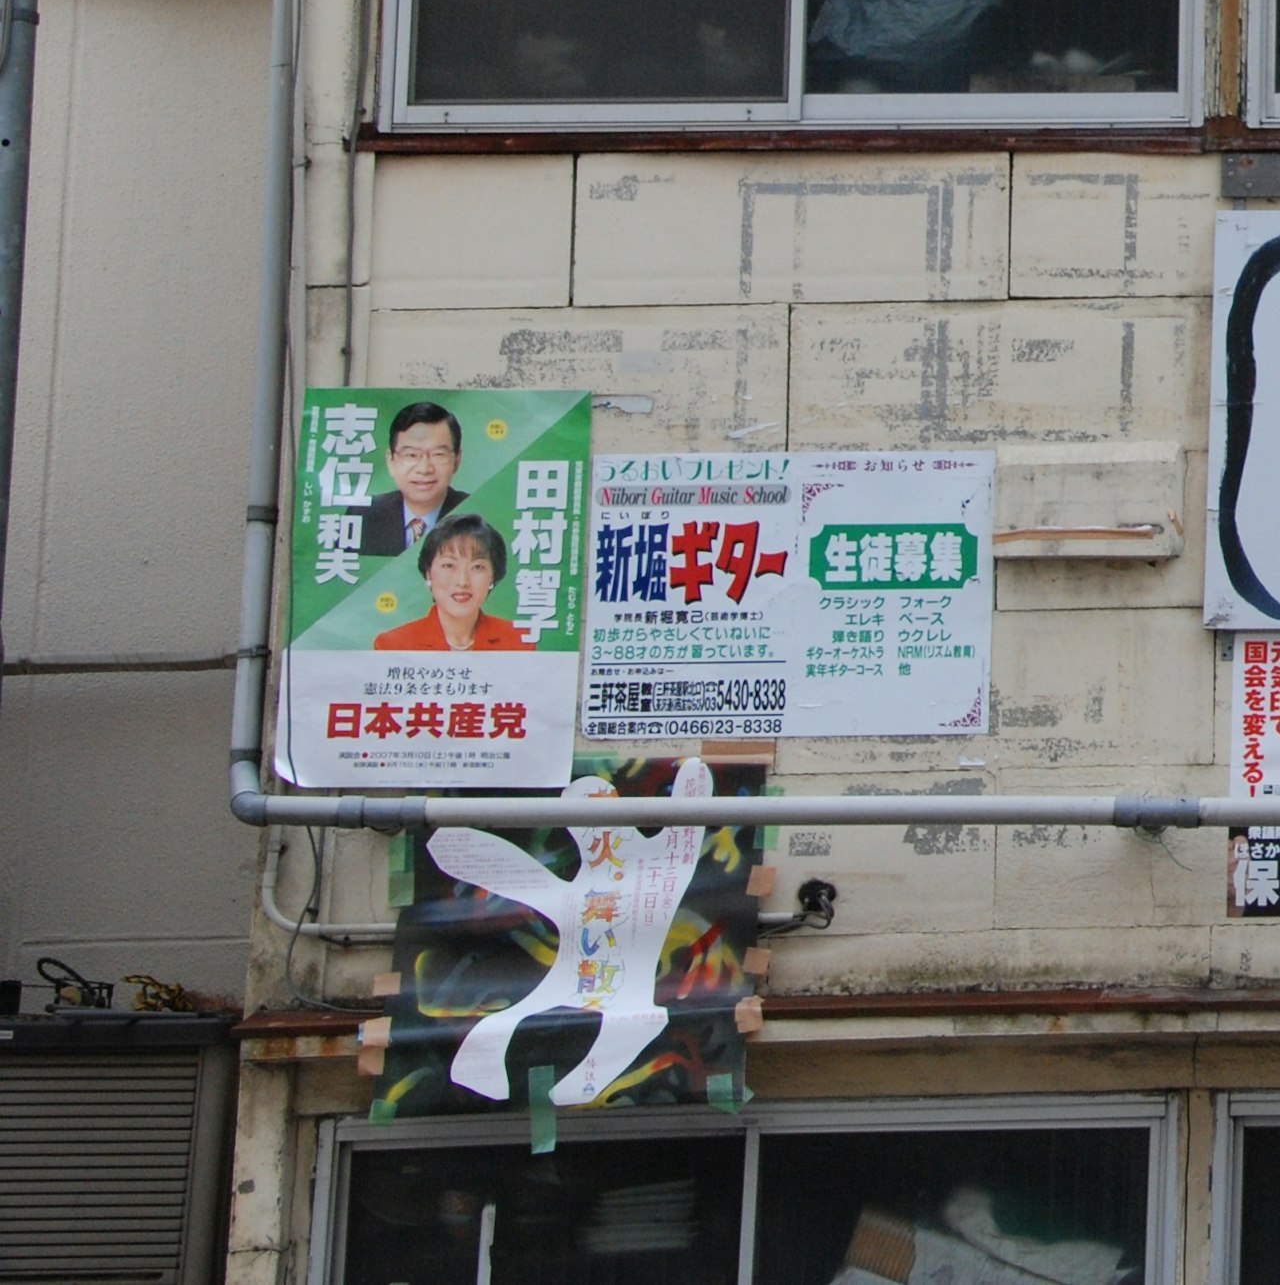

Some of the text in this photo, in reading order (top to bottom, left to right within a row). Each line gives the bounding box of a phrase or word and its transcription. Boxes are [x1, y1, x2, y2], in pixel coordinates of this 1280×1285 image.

[863, 459, 926, 472] お知らせ
[315, 403, 378, 585] 志位和夫
[602, 484, 788, 505] Niibori Guitar Music School
[511, 460, 569, 643] 田村智子
[825, 531, 963, 582] 生徒募集
[595, 520, 789, 606] 新堀ギター
[820, 596, 952, 609] クラシック フォーク
[845, 614, 945, 626] エレキ ベース
[832, 629, 952, 642] 弾き語り ウクレレ
[806, 647, 884, 659] ギターオーケストラ
[387, 667, 472, 680] 増税やめさせ
[805, 663, 911, 677] 実年ギターコース 他
[717, 679, 786, 712] 5430-8338
[326, 702, 527, 739] 日本共産党
[664, 719, 782, 735] (0466)23-8338
[1242, 641, 1268, 797] 国会を変える!
